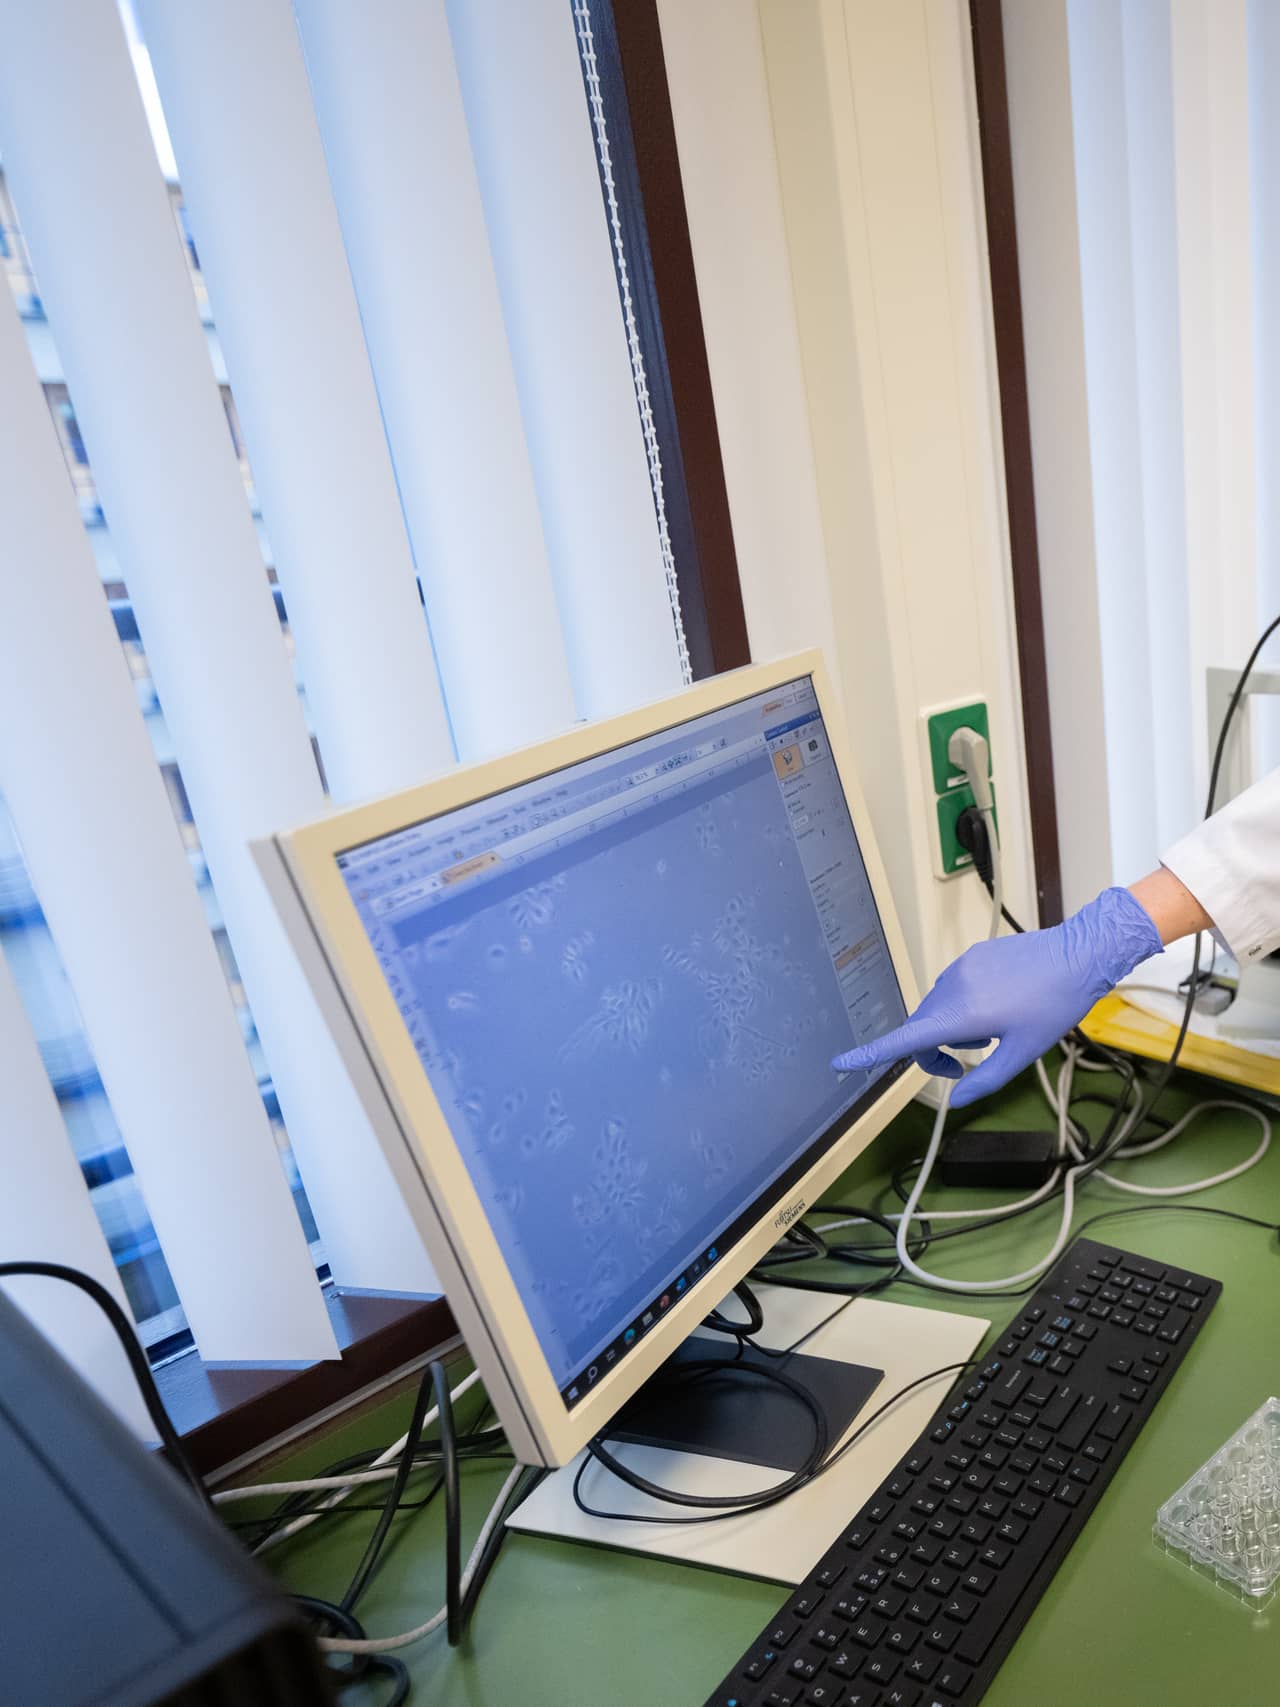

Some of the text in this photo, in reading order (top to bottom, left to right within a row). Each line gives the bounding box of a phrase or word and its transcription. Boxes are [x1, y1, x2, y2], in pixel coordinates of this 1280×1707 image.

[1002, 1524, 1012, 1533] M
[949, 1550, 959, 1559] H
[985, 1550, 995, 1558] N
[931, 1577, 940, 1585] G
[969, 1576, 978, 1584] B
[878, 1599, 888, 1607] R
[912, 1604, 919, 1612] F
[857, 1627, 868, 1636] E
[932, 1631, 942, 1639] C
[891, 1633, 902, 1642] D
[835, 1653, 848, 1664] W
[871, 1663, 881, 1672] S
[912, 1660, 922, 1670] X
[814, 1688, 825, 1697] Q
[891, 1692, 902, 1702] Z
[850, 1696, 860, 1704] A
